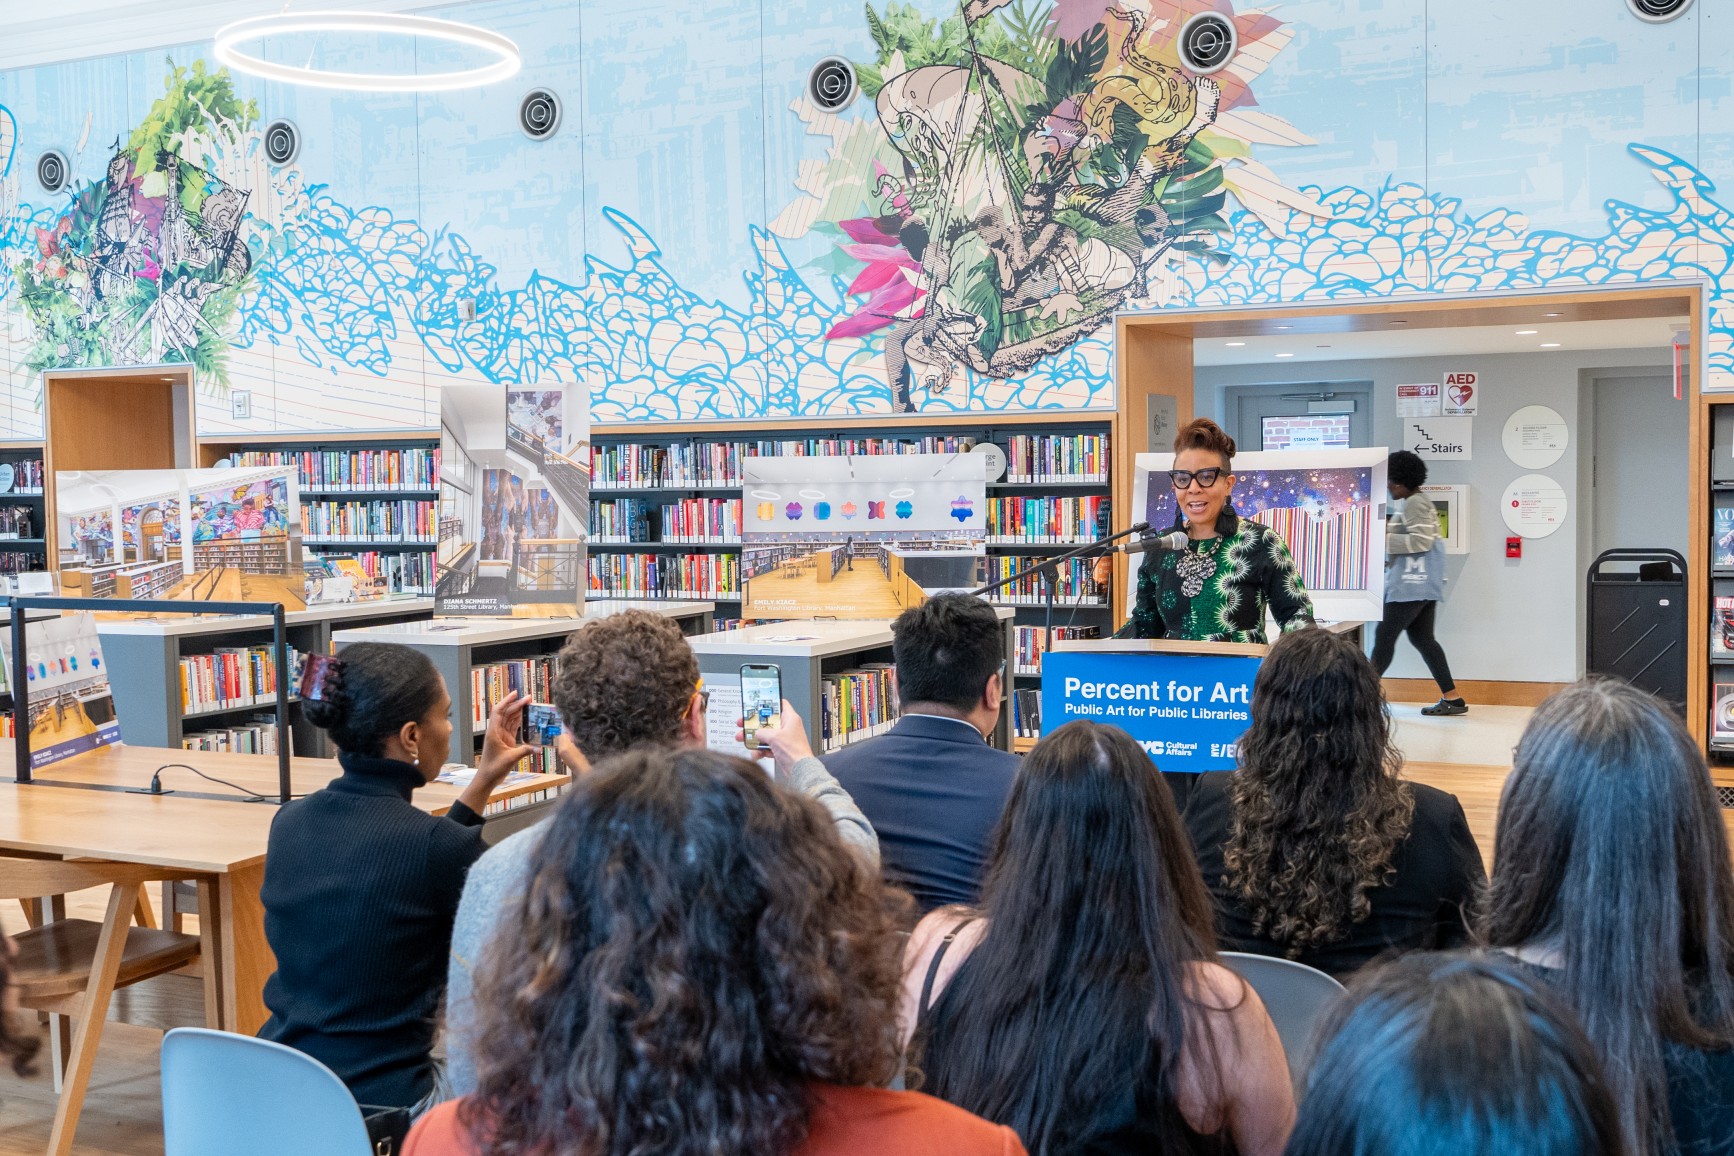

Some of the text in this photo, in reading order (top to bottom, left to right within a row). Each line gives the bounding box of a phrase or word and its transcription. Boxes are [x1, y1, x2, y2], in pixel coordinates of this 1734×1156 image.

[1446, 373, 1476, 384] AED
[1420, 386, 1437, 395] 911
[1431, 443, 1463, 453] Stairs
[1717, 509, 1734, 521] VO
[1404, 556, 1426, 573] M
[1716, 596, 1731, 609] HOT
[1064, 677, 1249, 704] Percent for Art
[1064, 703, 1248, 721] Public Art for Public Libraries
[1136, 740, 1164, 754] YC
[1166, 741, 1197, 750] Cultural
[1166, 748, 1192, 756] Affairs
